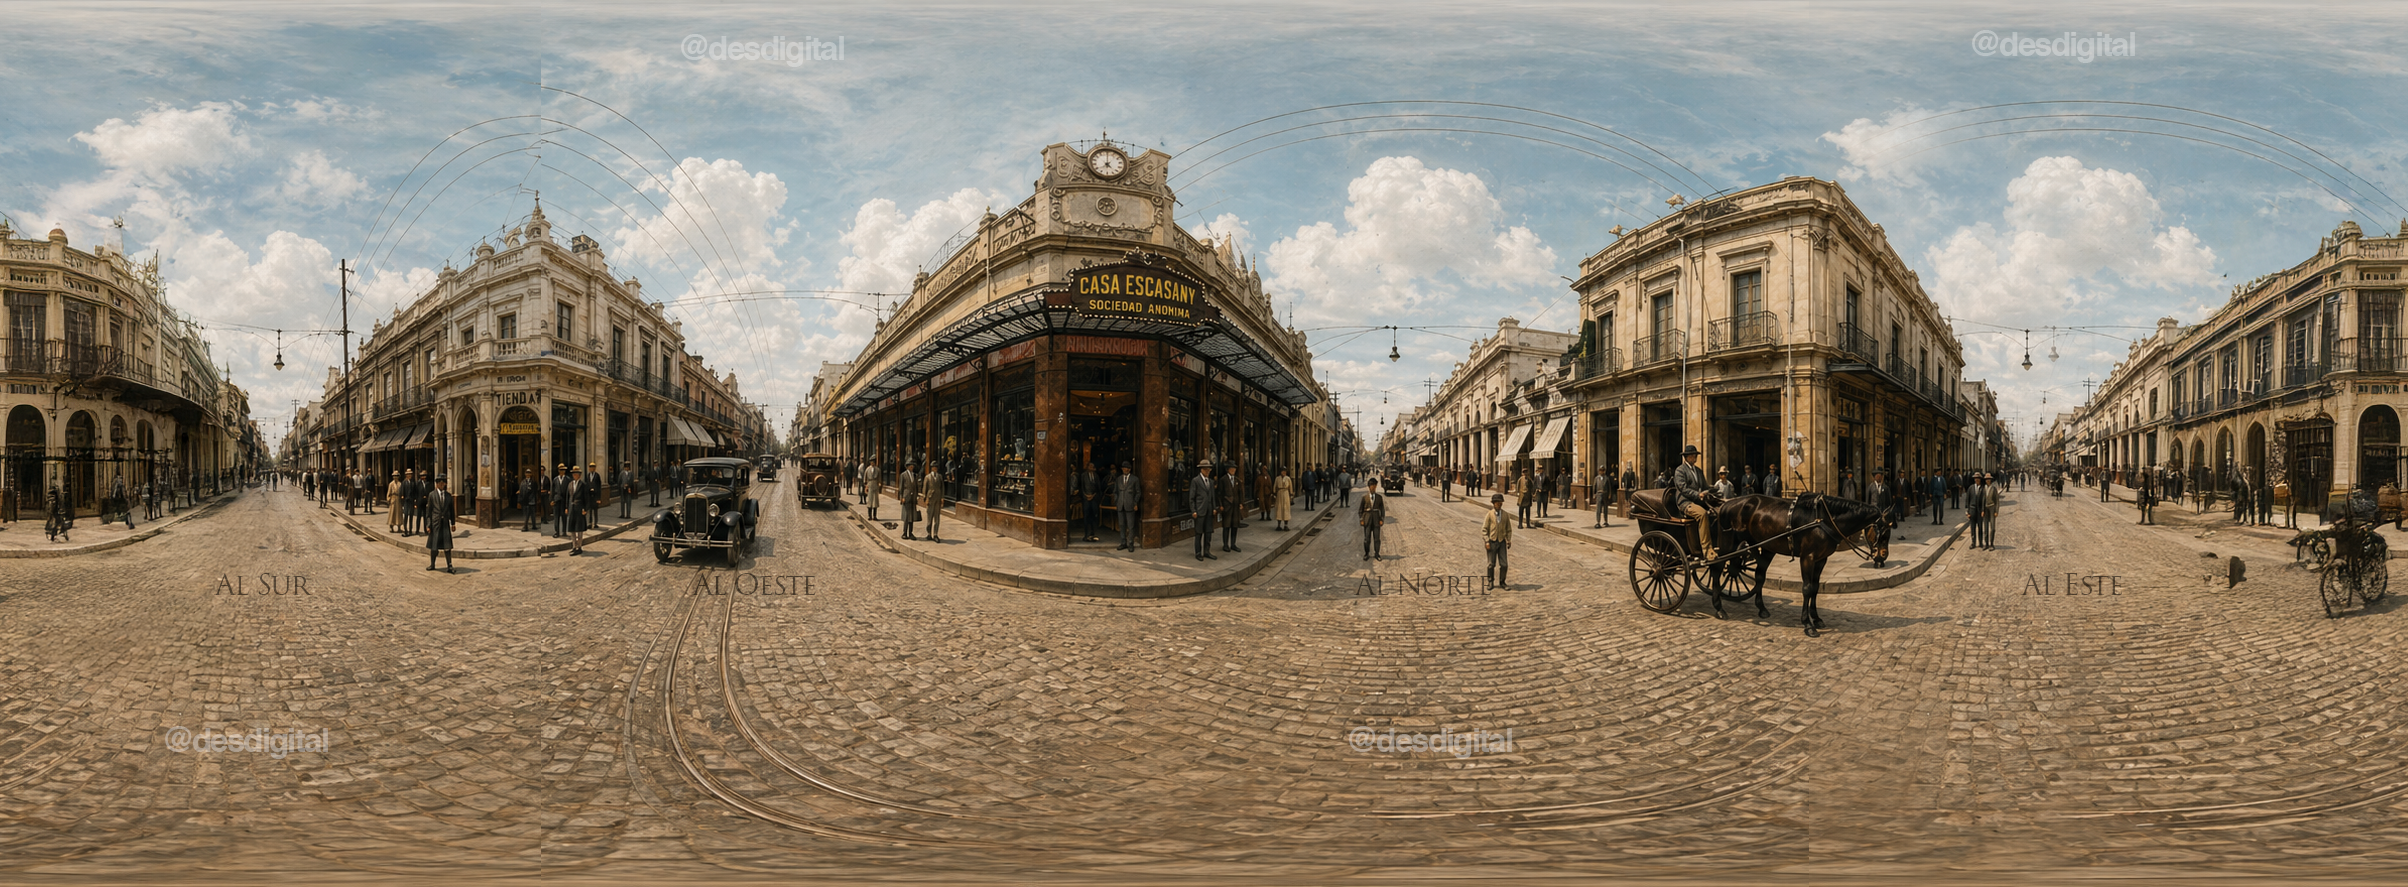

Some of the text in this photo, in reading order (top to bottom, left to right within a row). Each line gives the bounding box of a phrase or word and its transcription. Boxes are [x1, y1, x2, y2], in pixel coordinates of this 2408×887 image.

[1080, 274, 1196, 305] CASA ESCASANY
[1089, 299, 1143, 313] SOCIEDAD
